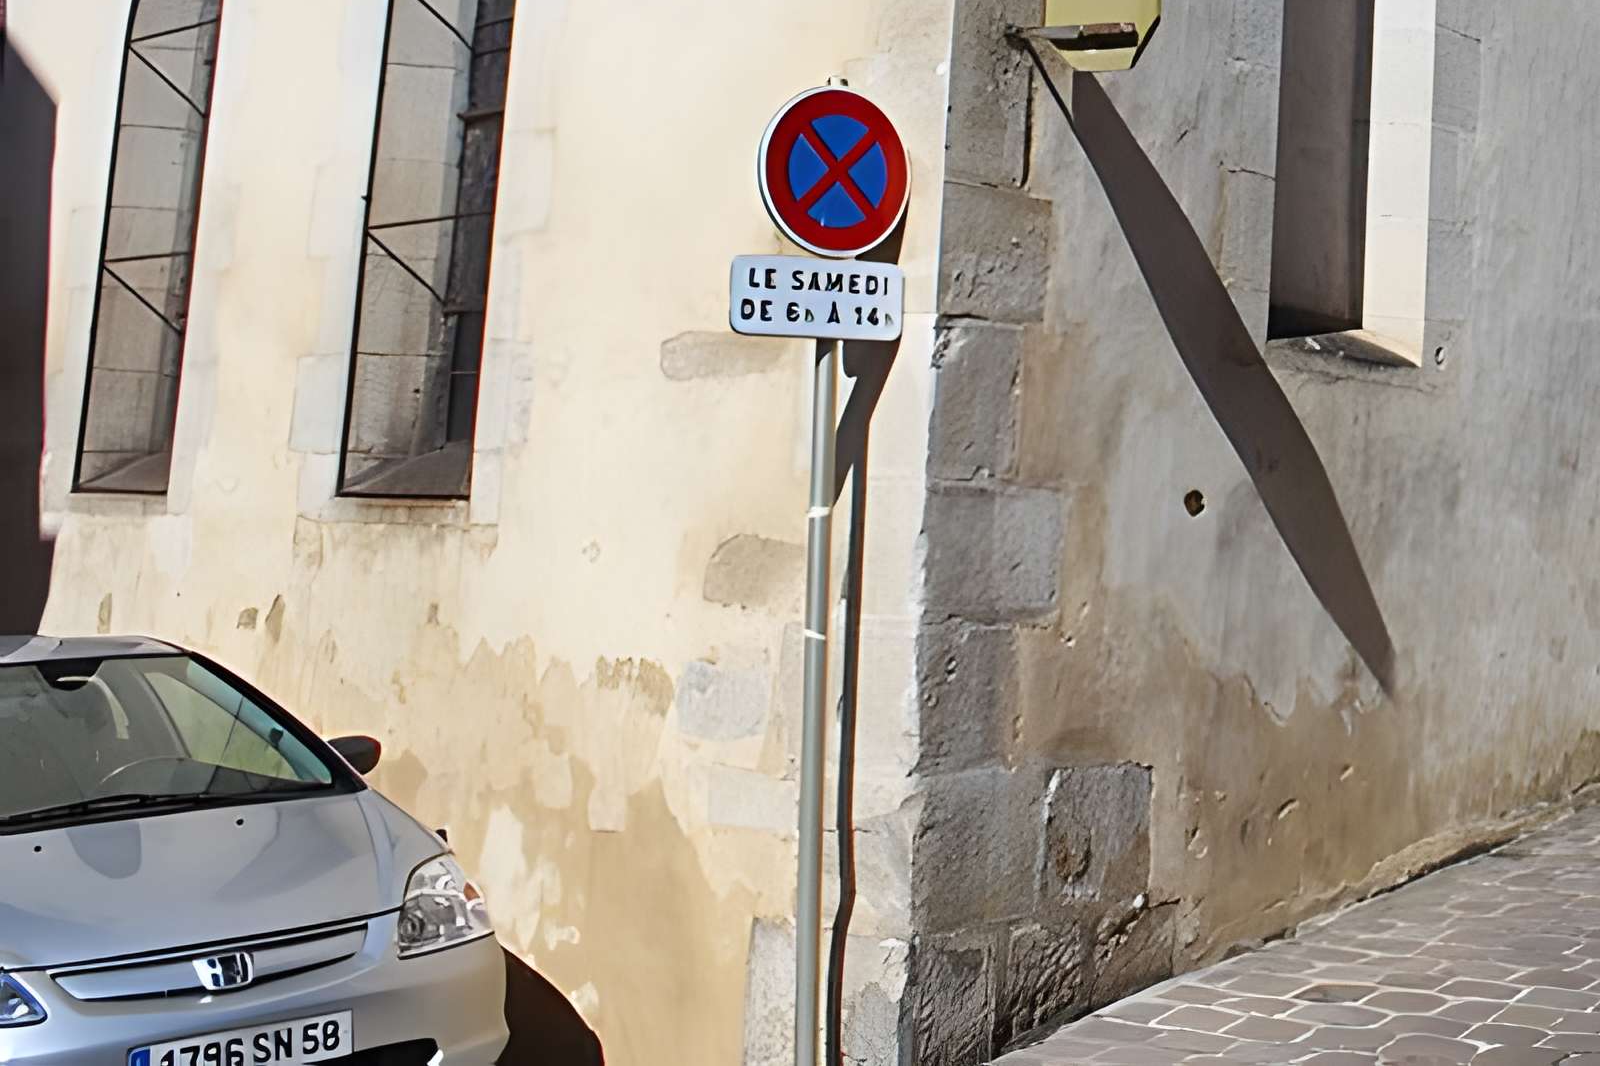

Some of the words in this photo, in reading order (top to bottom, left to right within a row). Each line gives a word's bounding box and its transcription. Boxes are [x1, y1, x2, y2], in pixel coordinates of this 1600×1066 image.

[748, 267, 777, 289] LE
[791, 270, 889, 296] SAMEDI
[740, 298, 773, 322] DE
[253, 1027, 293, 1063] SN
[302, 1020, 341, 1055] 58
